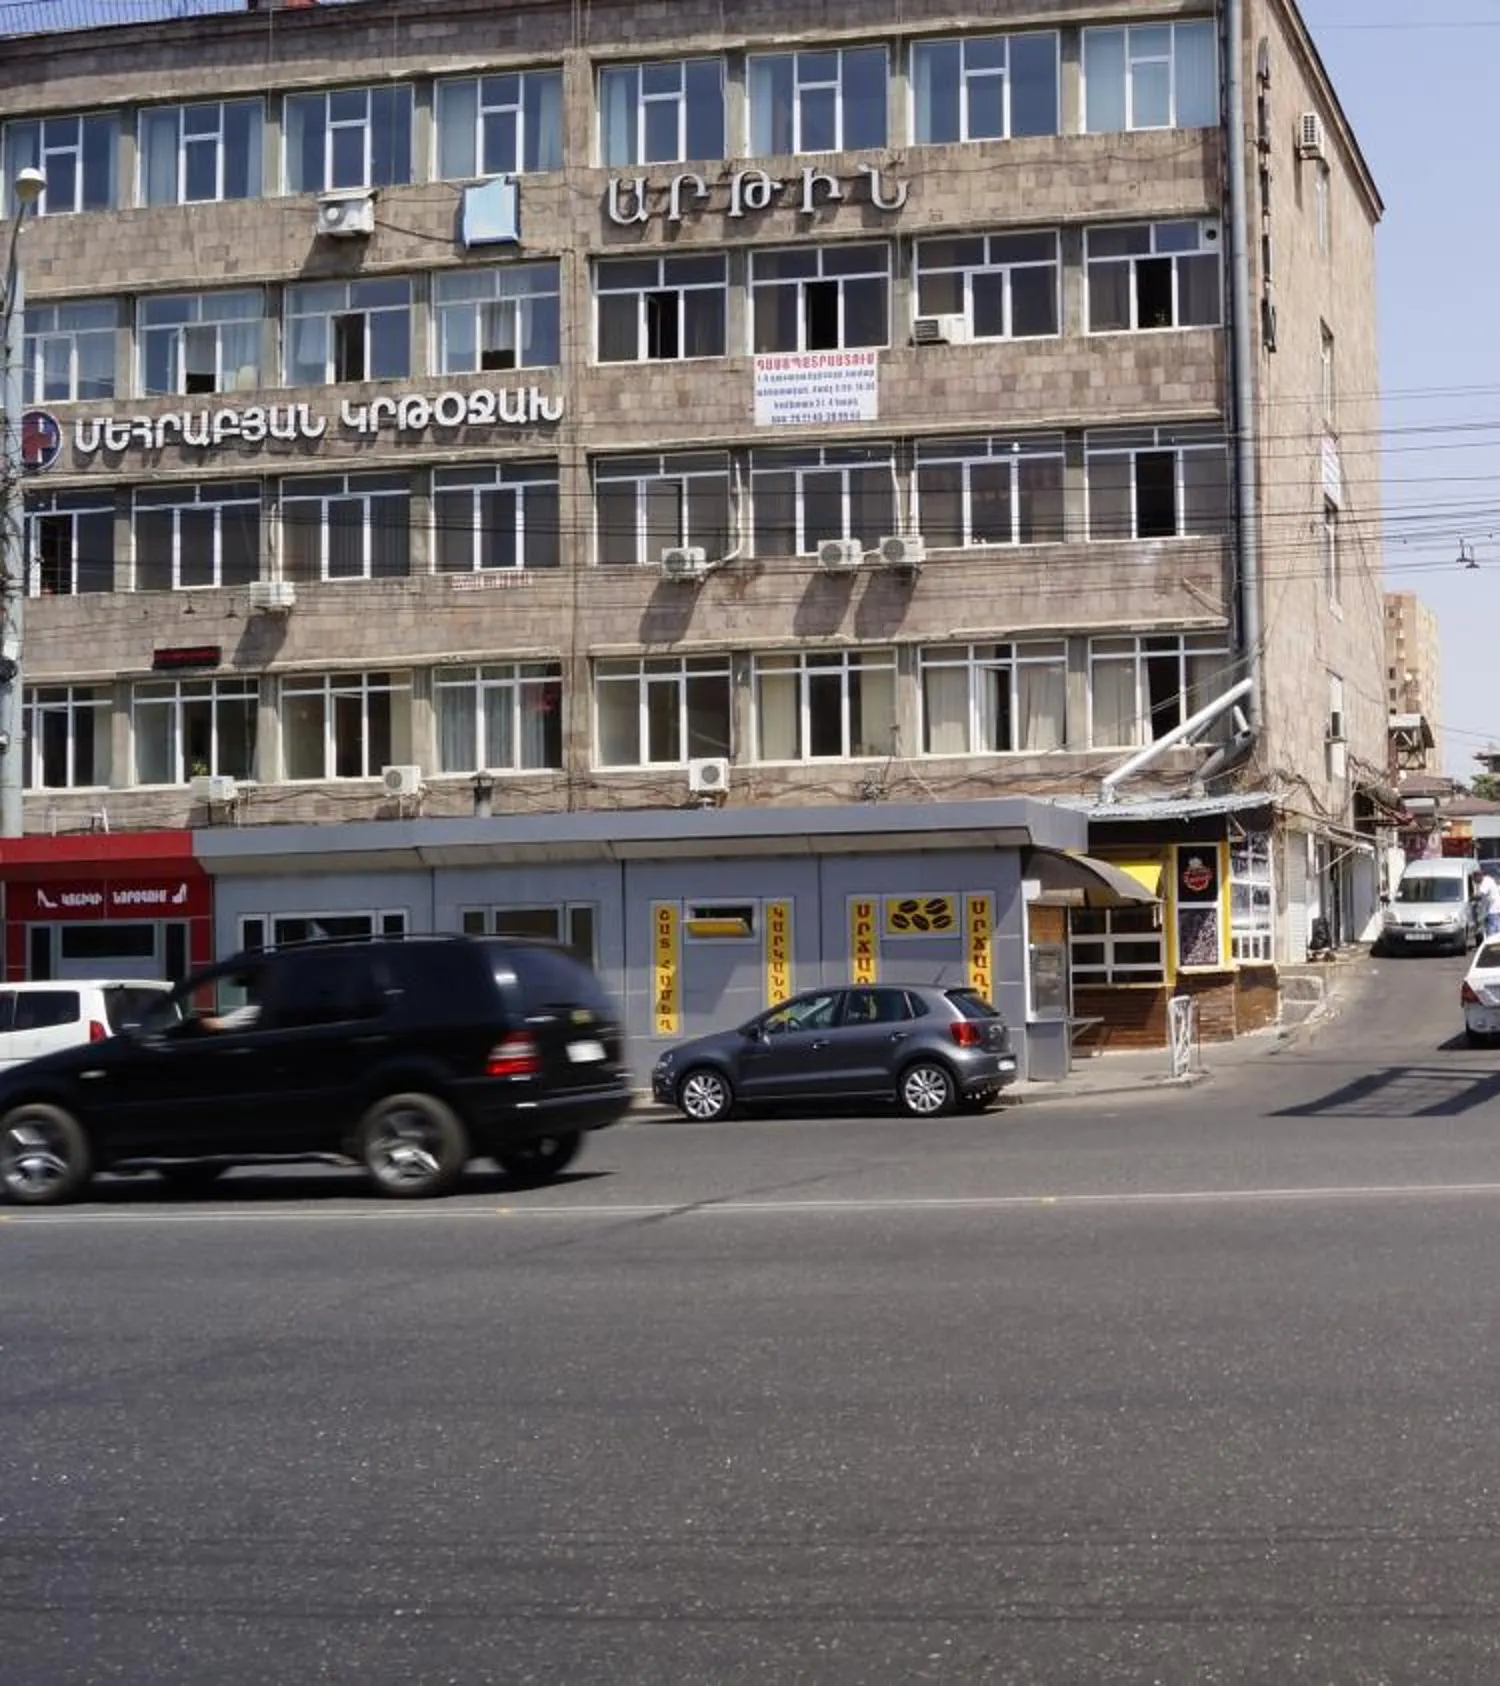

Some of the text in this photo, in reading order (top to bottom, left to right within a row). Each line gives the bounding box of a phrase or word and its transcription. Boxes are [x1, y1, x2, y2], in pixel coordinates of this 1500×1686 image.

[608, 163, 908, 225] ԱՐԹԻՆ
[75, 386, 564, 453] ՄԵՀՐԱԲՅԱՆ ԿՐԹՕՋԱԽ
